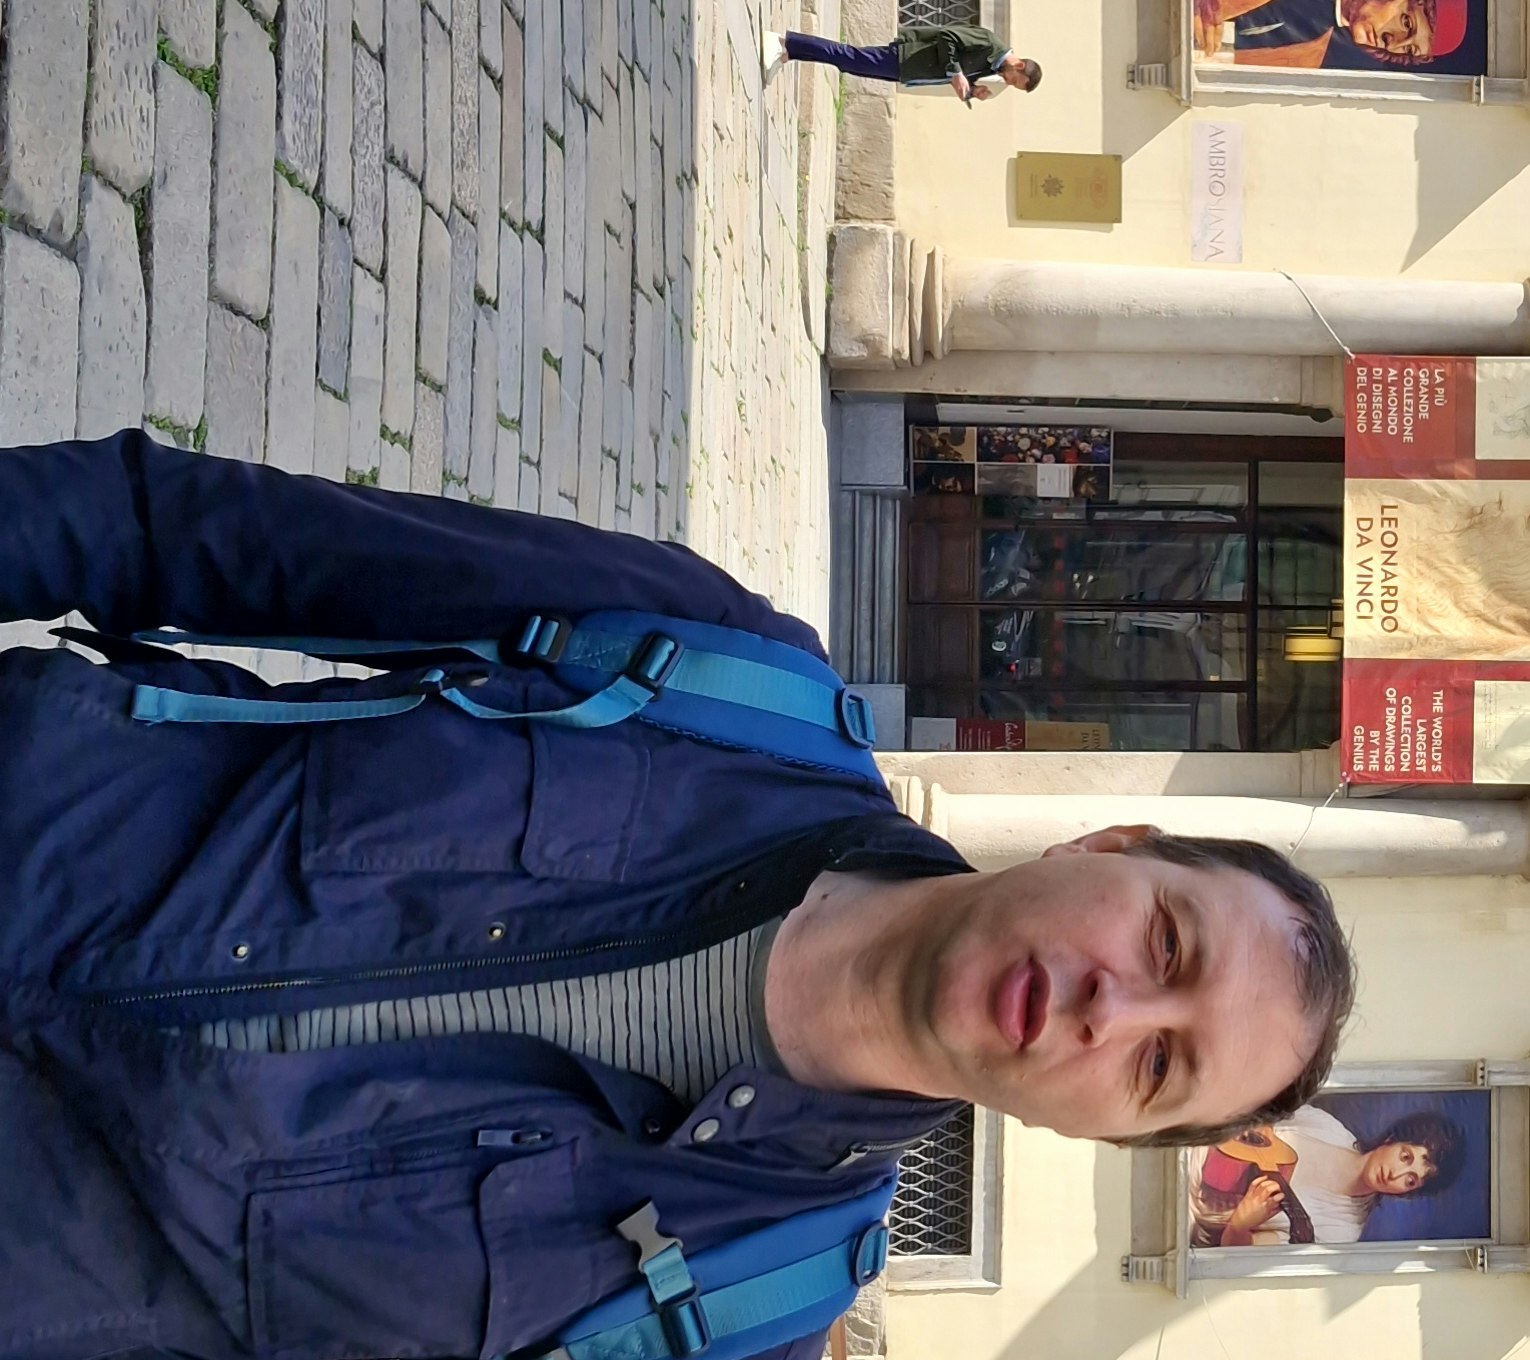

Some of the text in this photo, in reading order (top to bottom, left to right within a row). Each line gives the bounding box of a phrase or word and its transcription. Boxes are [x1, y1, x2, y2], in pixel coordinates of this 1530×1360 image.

[1204, 124, 1226, 262] AMBROSIANA
[1357, 367, 1367, 433] DEL GENIO
[1372, 368, 1382, 433] DI DISEGNI
[1388, 368, 1398, 435] AL MONDO
[1403, 368, 1414, 443] COLLEZIONE
[1419, 368, 1429, 420] GRANDE
[1434, 368, 1447, 406] LA PIÙ
[1356, 517, 1374, 619] DA VINCI
[1380, 505, 1399, 633] LEONARDO
[1353, 726, 1364, 771] GENIUS
[1369, 731, 1380, 771] BY THE
[1385, 688, 1396, 771] OF DRAWINGS
[1400, 696, 1412, 771] COLLECTION
[1416, 719, 1427, 772] LARGEST
[1432, 690, 1443, 772] THE WORLD'S
